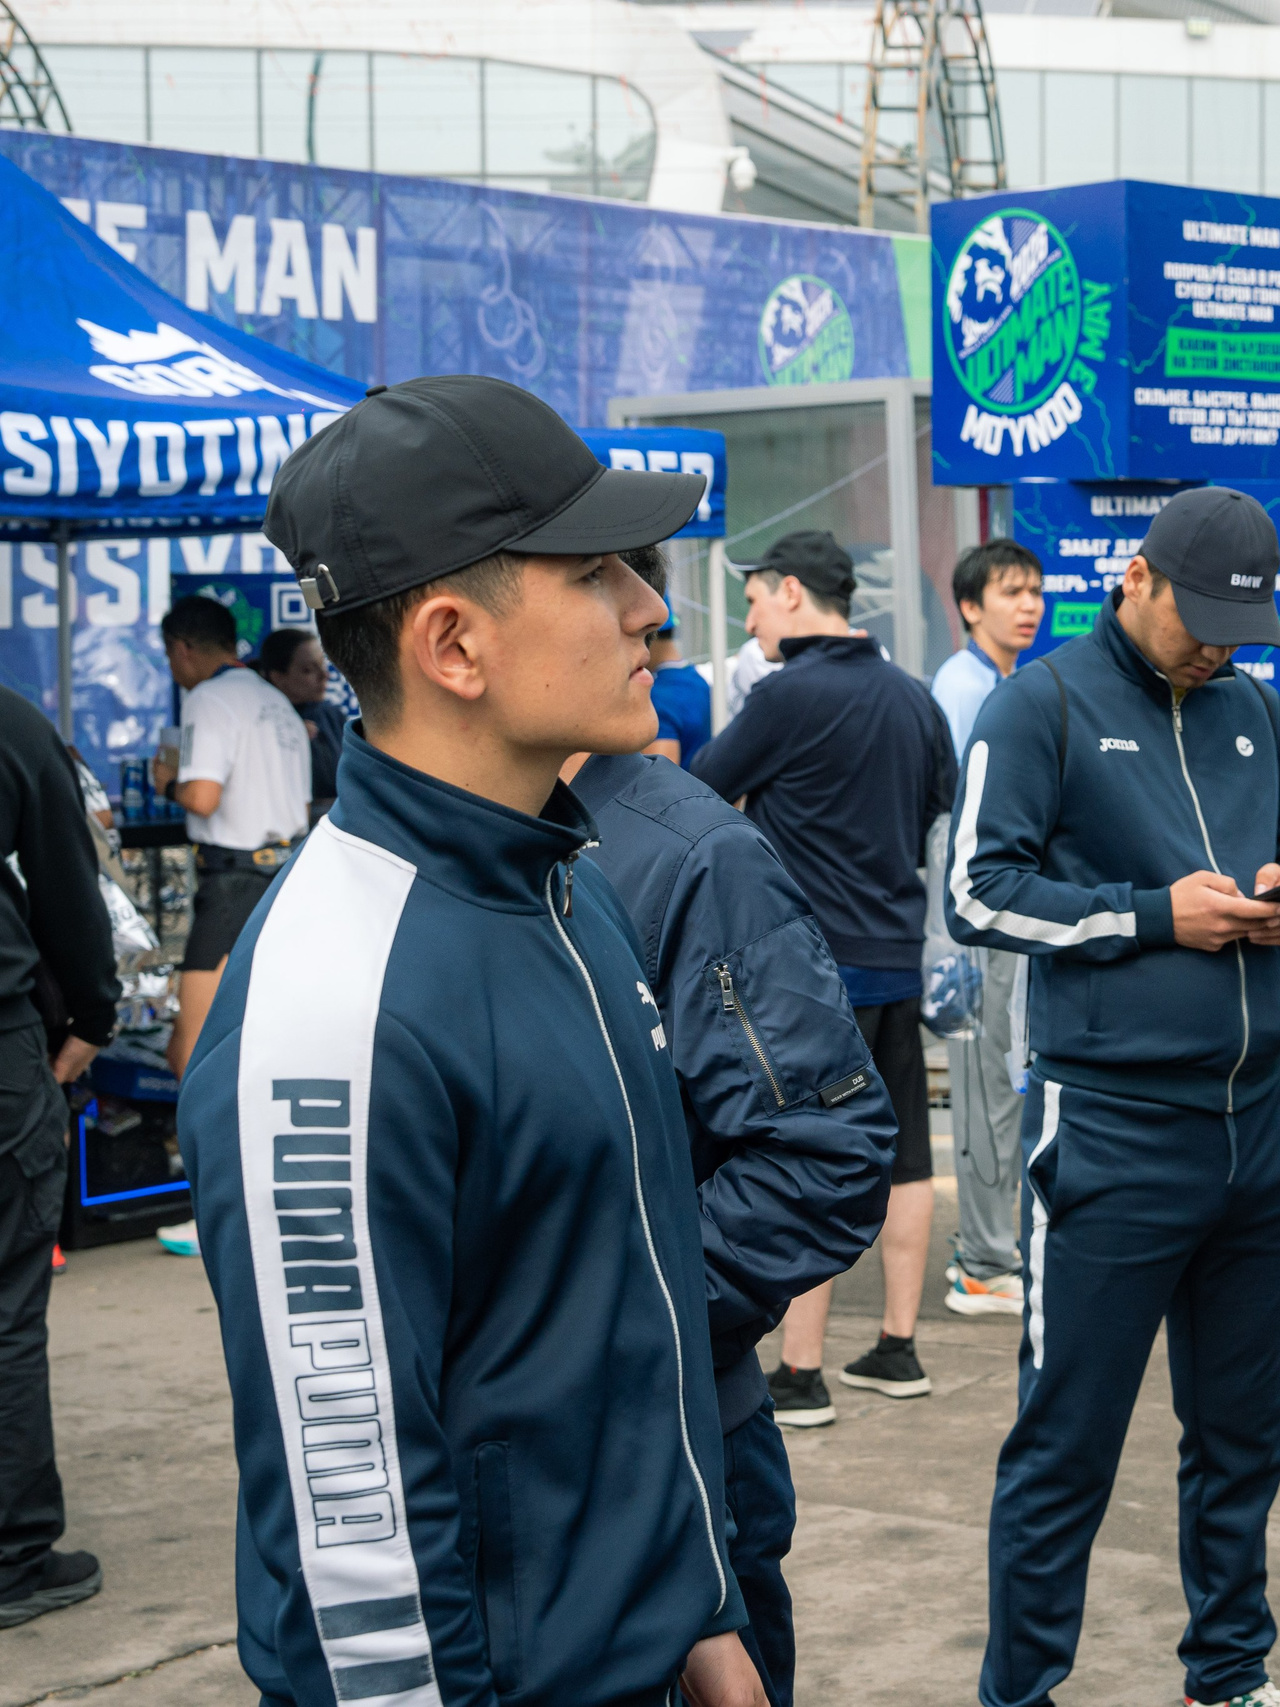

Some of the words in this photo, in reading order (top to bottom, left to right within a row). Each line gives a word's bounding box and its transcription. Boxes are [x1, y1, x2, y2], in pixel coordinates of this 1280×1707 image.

[186, 209, 377, 323] MAN
[1183, 219, 1249, 246] ULTIMATE
[1250, 226, 1280, 249] MAN
[1015, 302, 1078, 404] MAN
[1077, 278, 1113, 363] MAY
[1230, 573, 1263, 589] BMW
[851, 1074, 865, 1086] DUB
[271, 1078, 365, 1315] PUMA
[289, 1318, 397, 1548] PUMA
